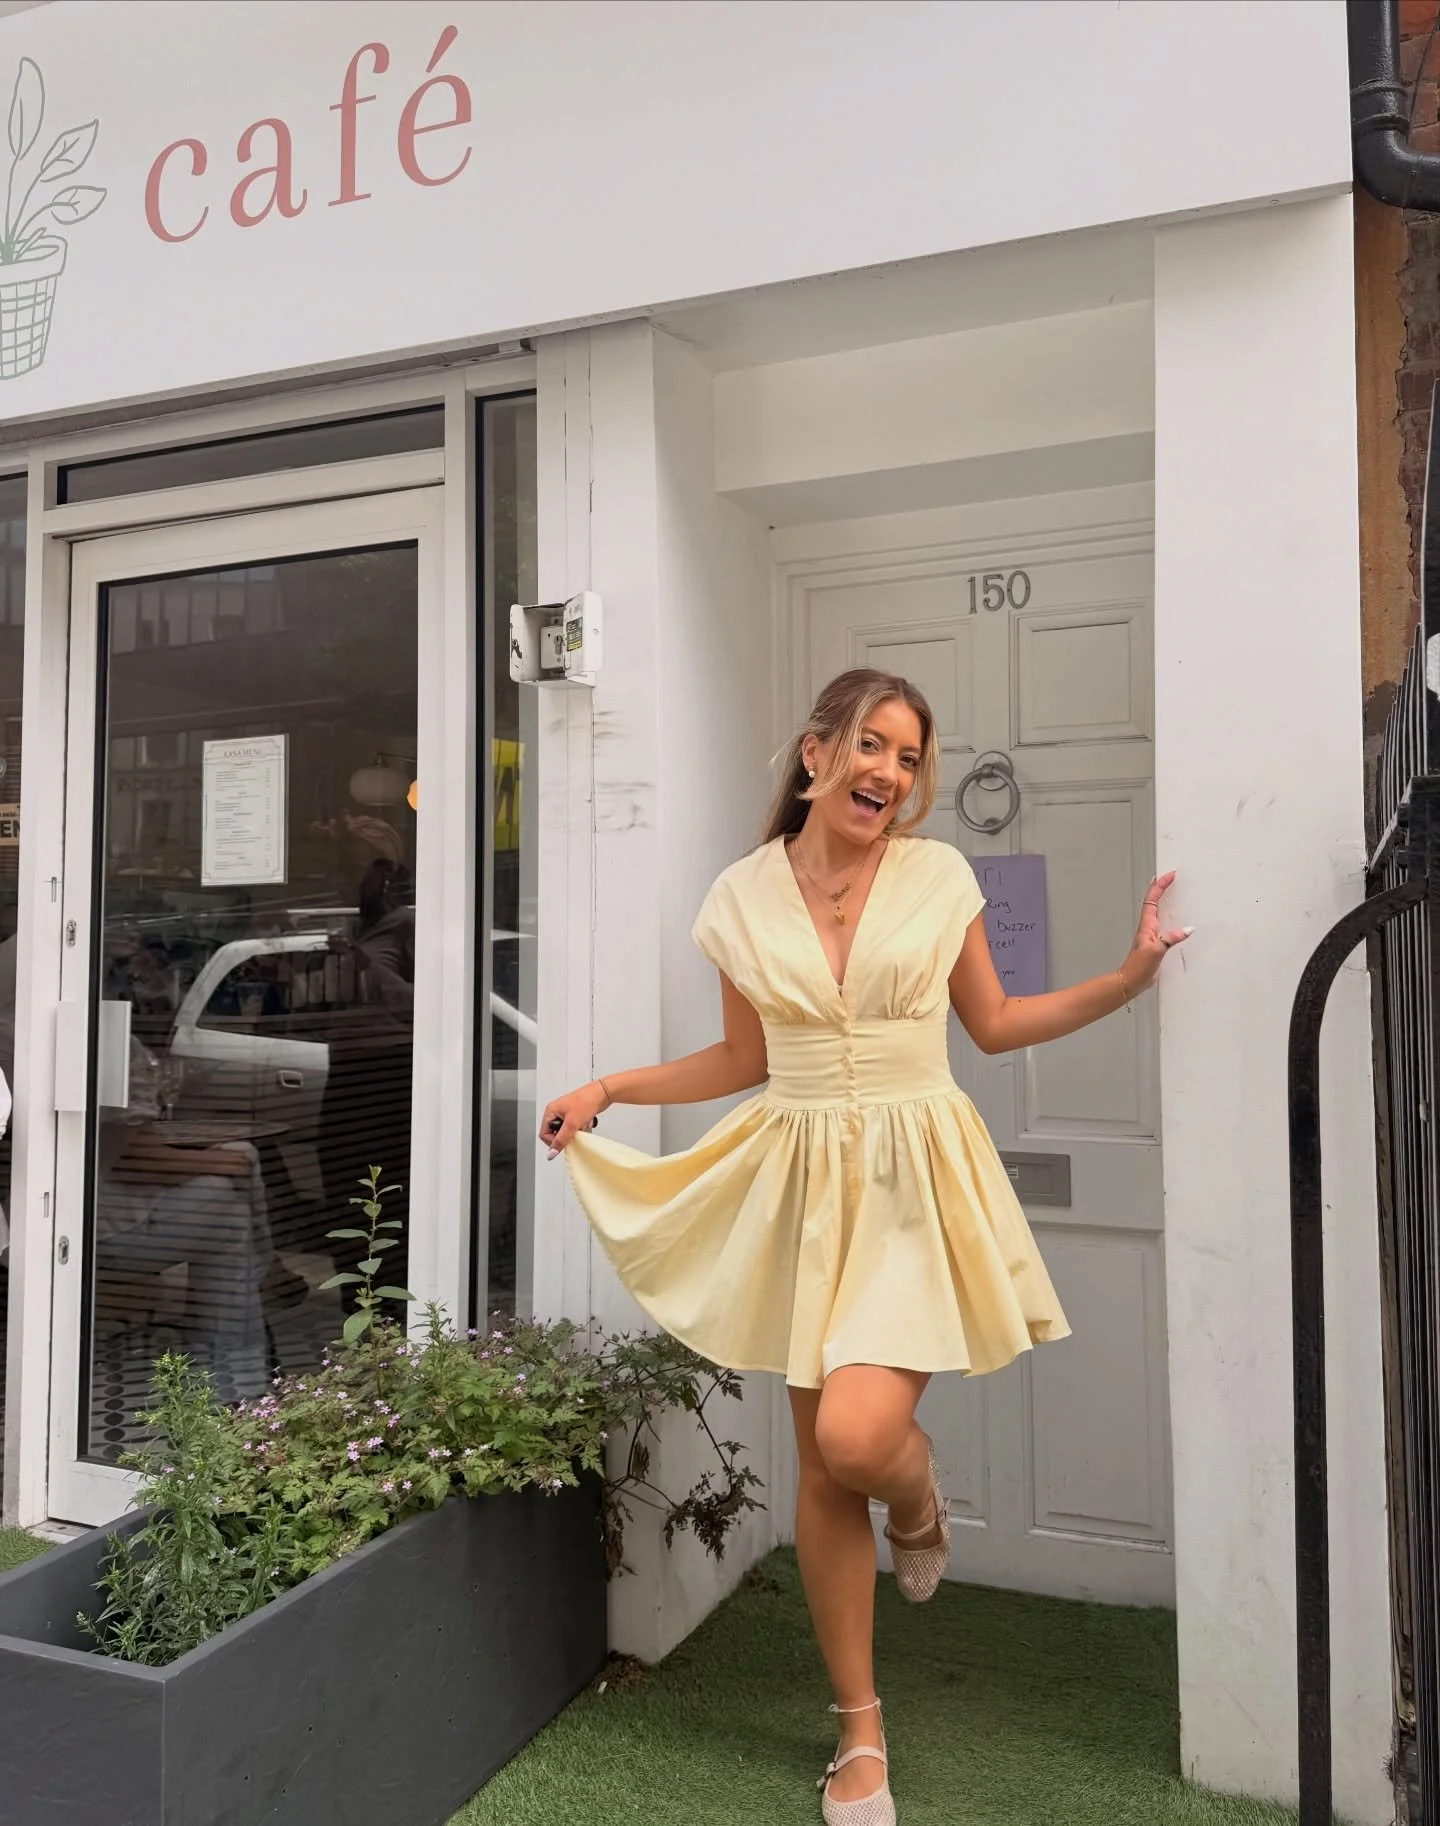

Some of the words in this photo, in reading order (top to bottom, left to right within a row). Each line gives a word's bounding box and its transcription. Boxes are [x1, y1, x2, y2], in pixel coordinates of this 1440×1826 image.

[145, 25, 472, 243] café
[967, 570, 1031, 614] 150
[997, 919, 1036, 932] buzzer
[988, 938, 1015, 949] rcell
